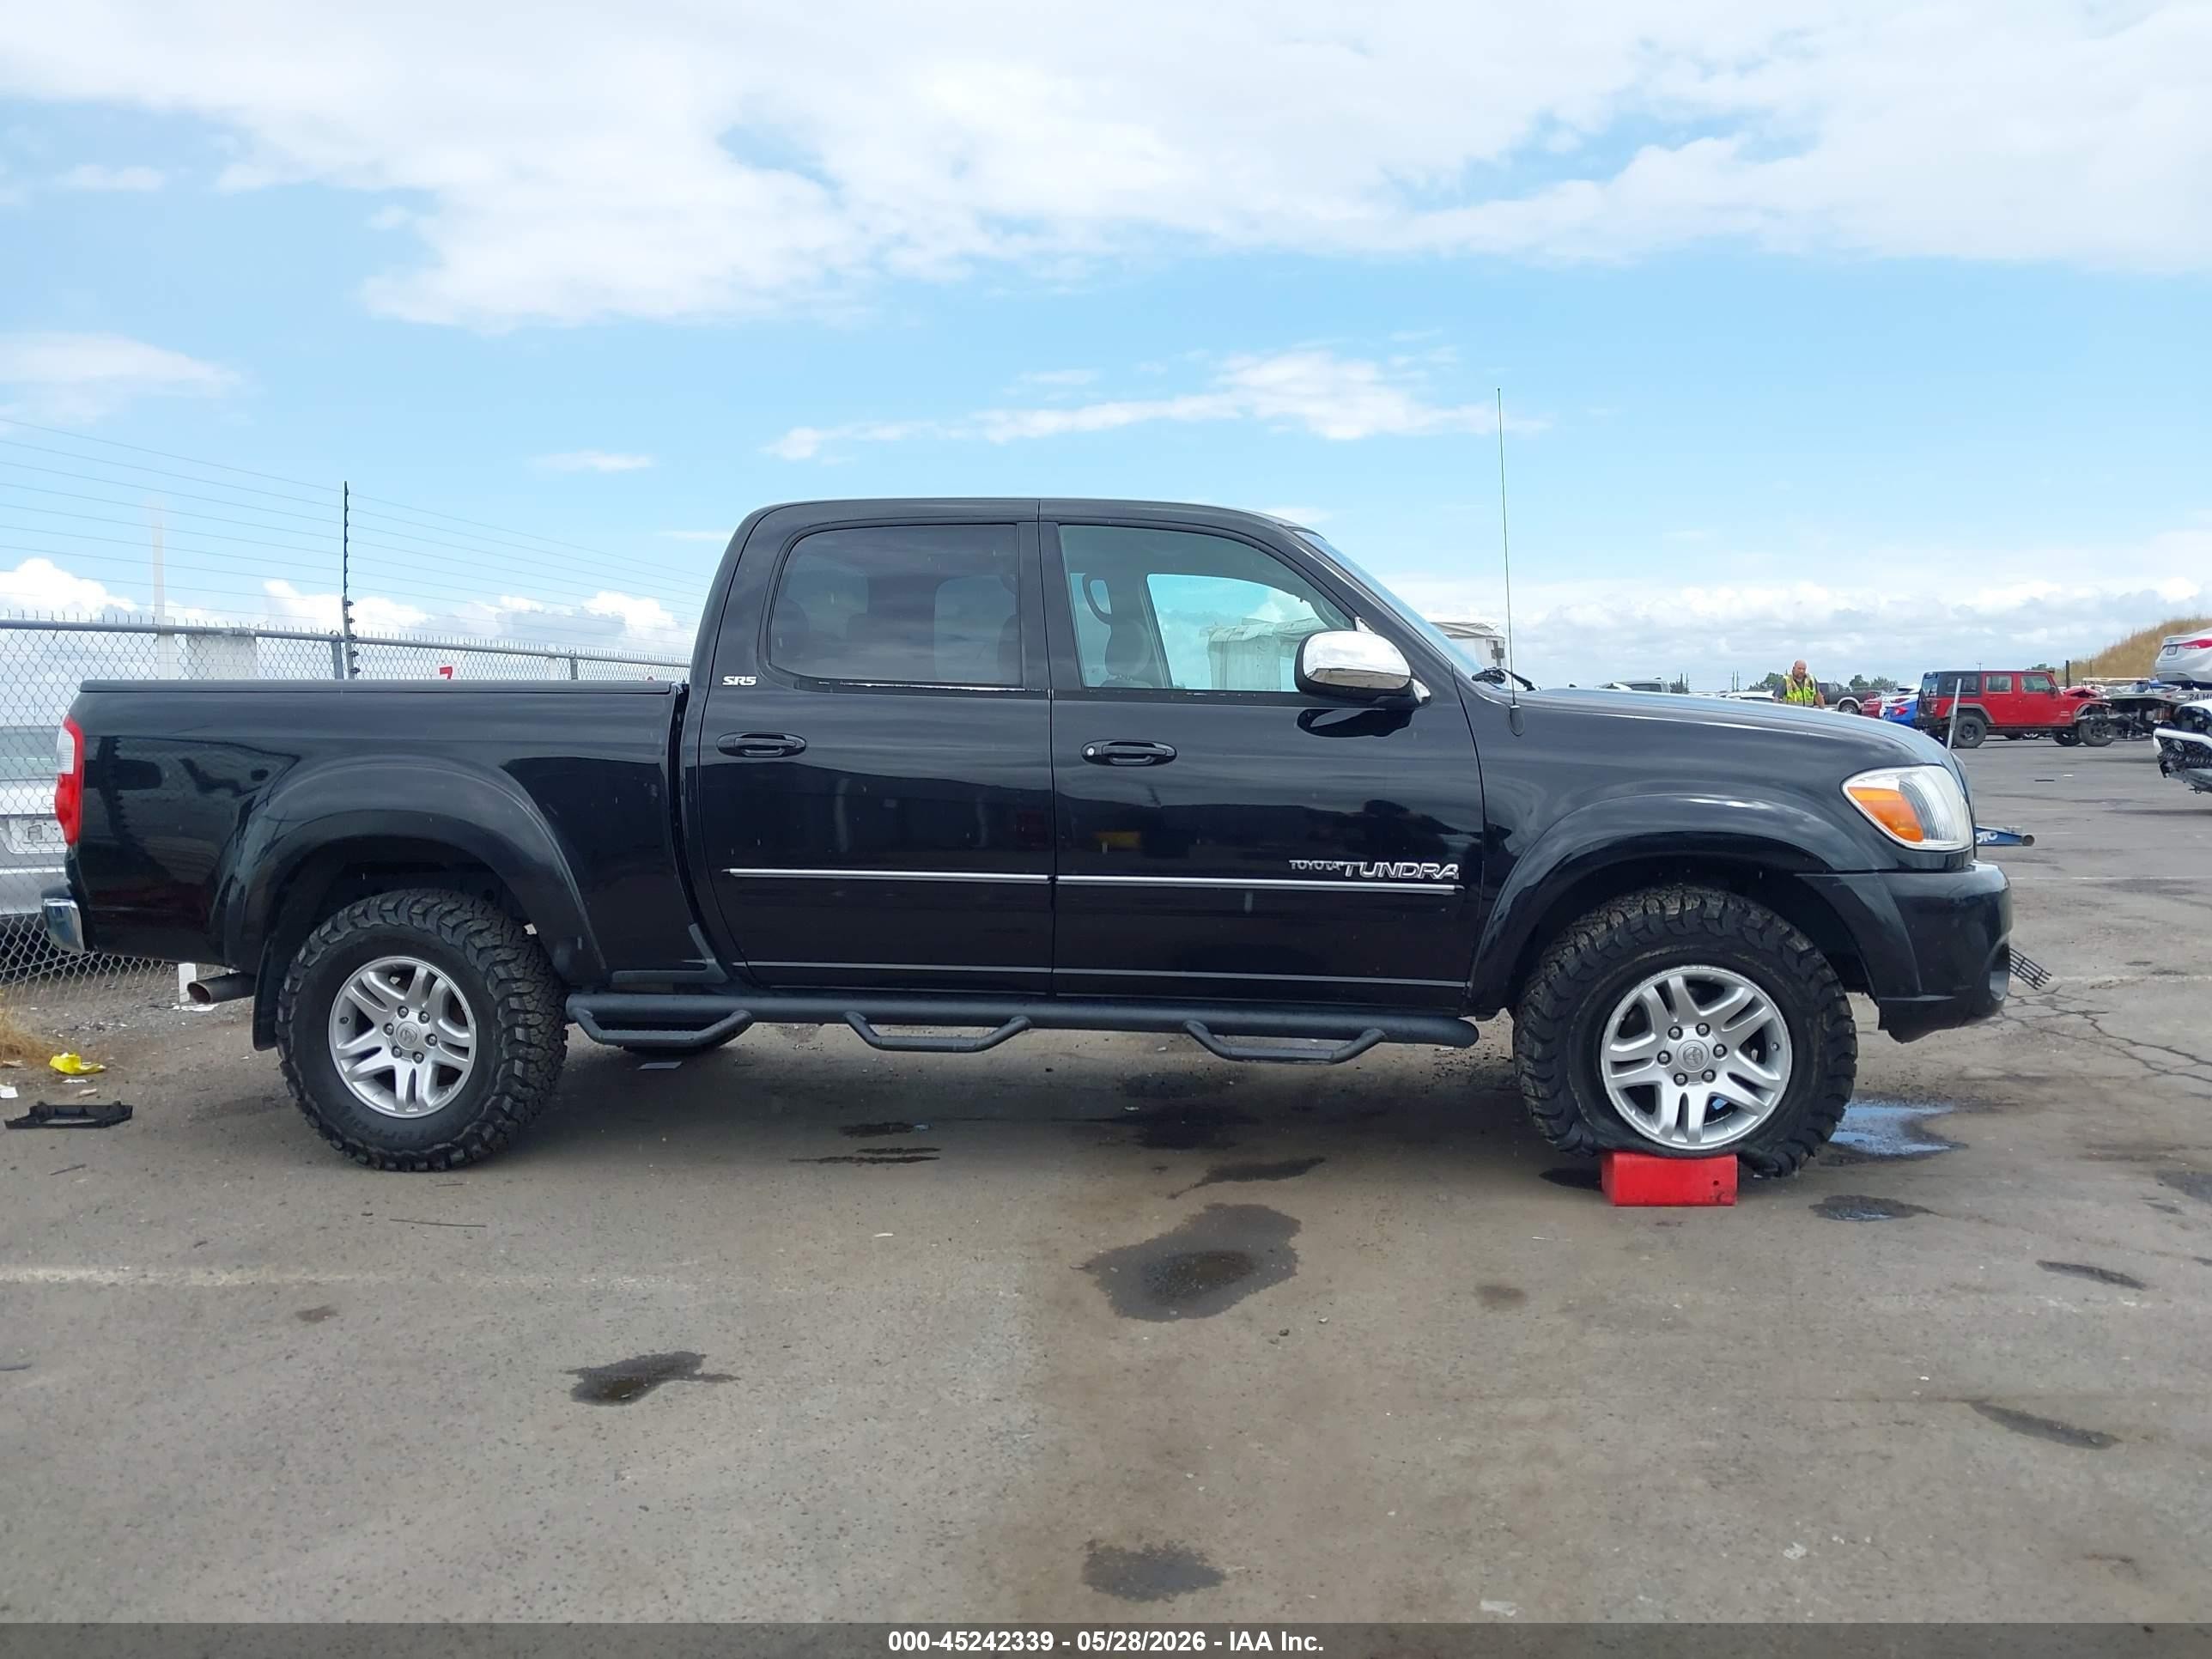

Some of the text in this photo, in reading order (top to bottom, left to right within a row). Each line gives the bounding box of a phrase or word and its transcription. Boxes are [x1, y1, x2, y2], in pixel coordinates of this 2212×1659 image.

[722, 676, 757, 686] SR5
[1289, 860, 1459, 880] TOYOTA TUNDRA
